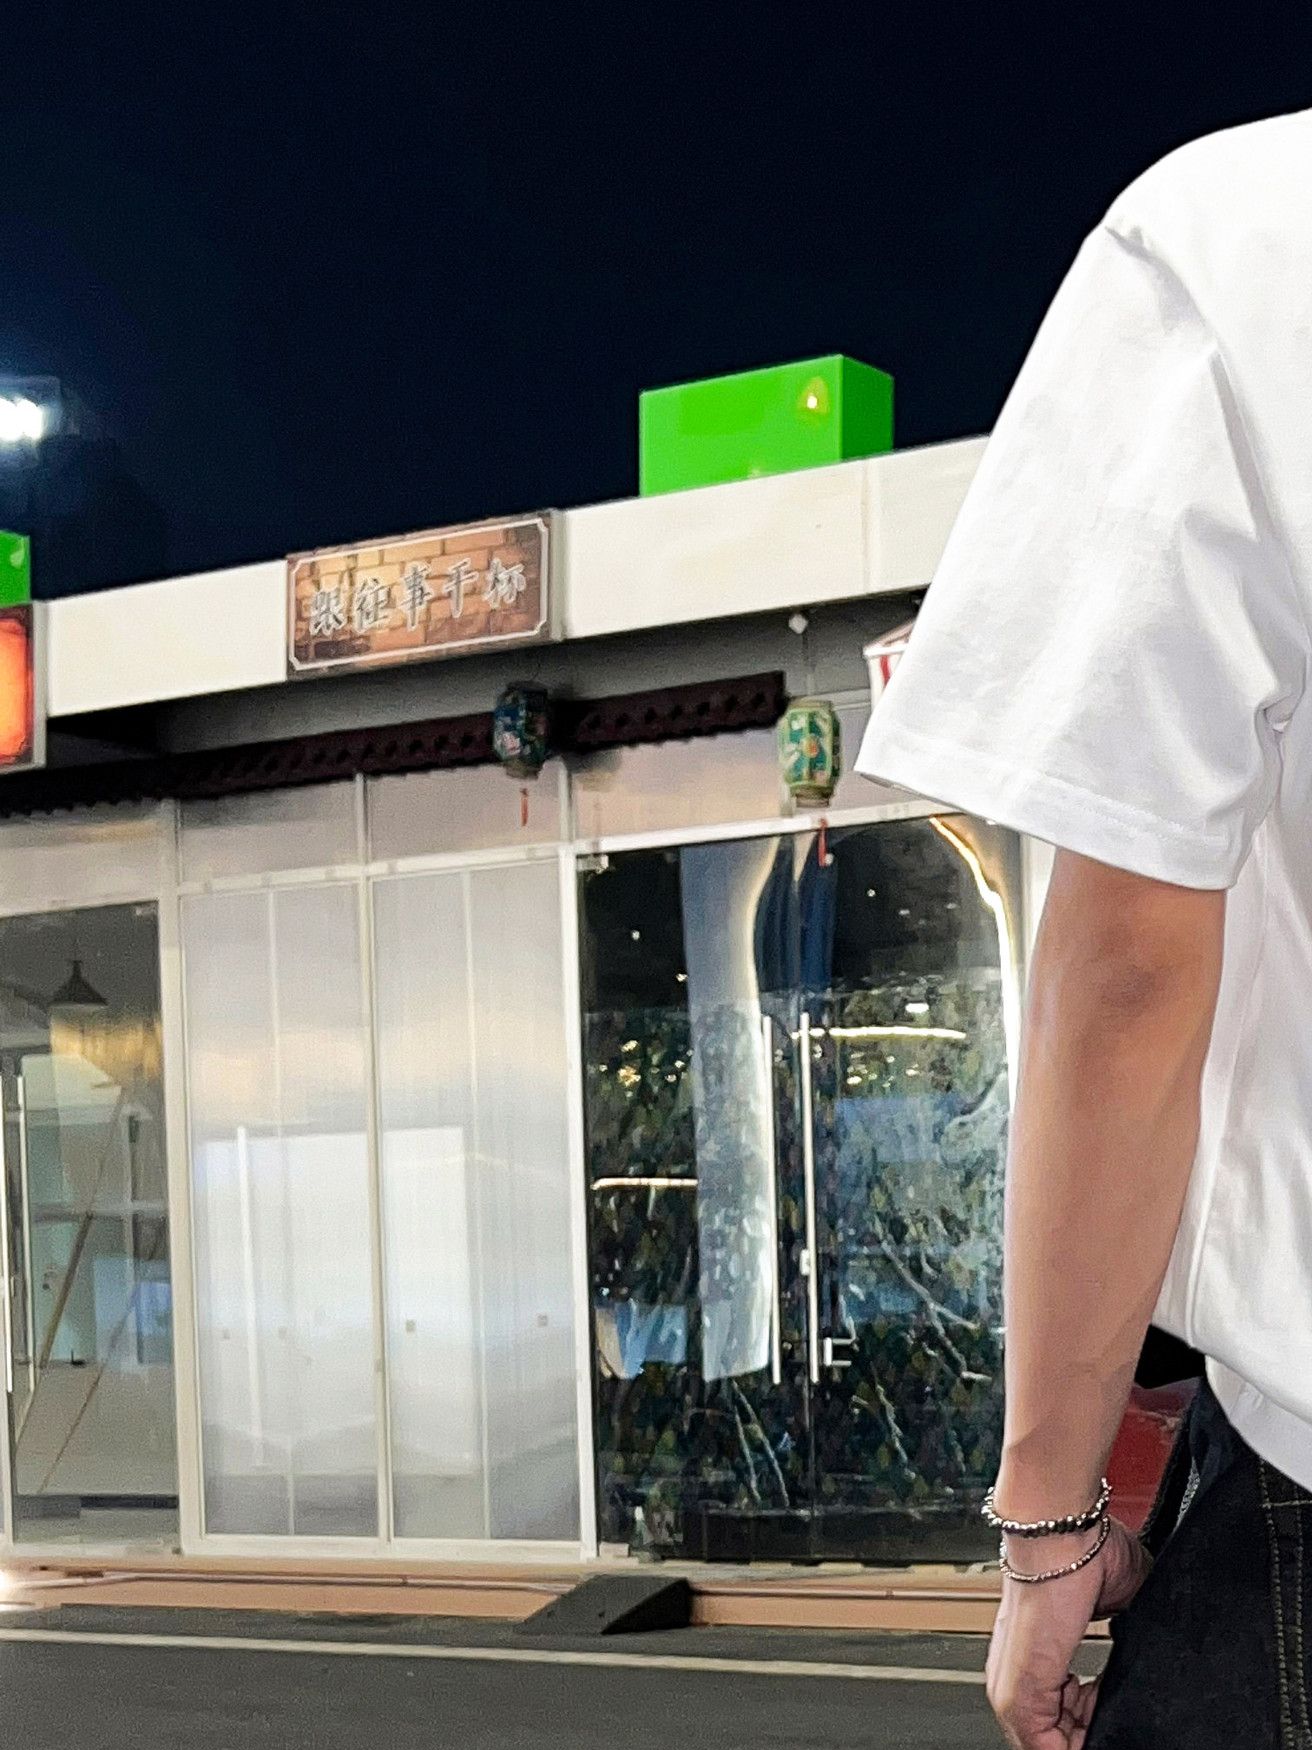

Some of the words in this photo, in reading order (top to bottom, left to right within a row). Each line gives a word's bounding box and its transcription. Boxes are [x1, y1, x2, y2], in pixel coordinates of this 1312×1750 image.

[311, 559, 527, 635] 跟往事干杯
